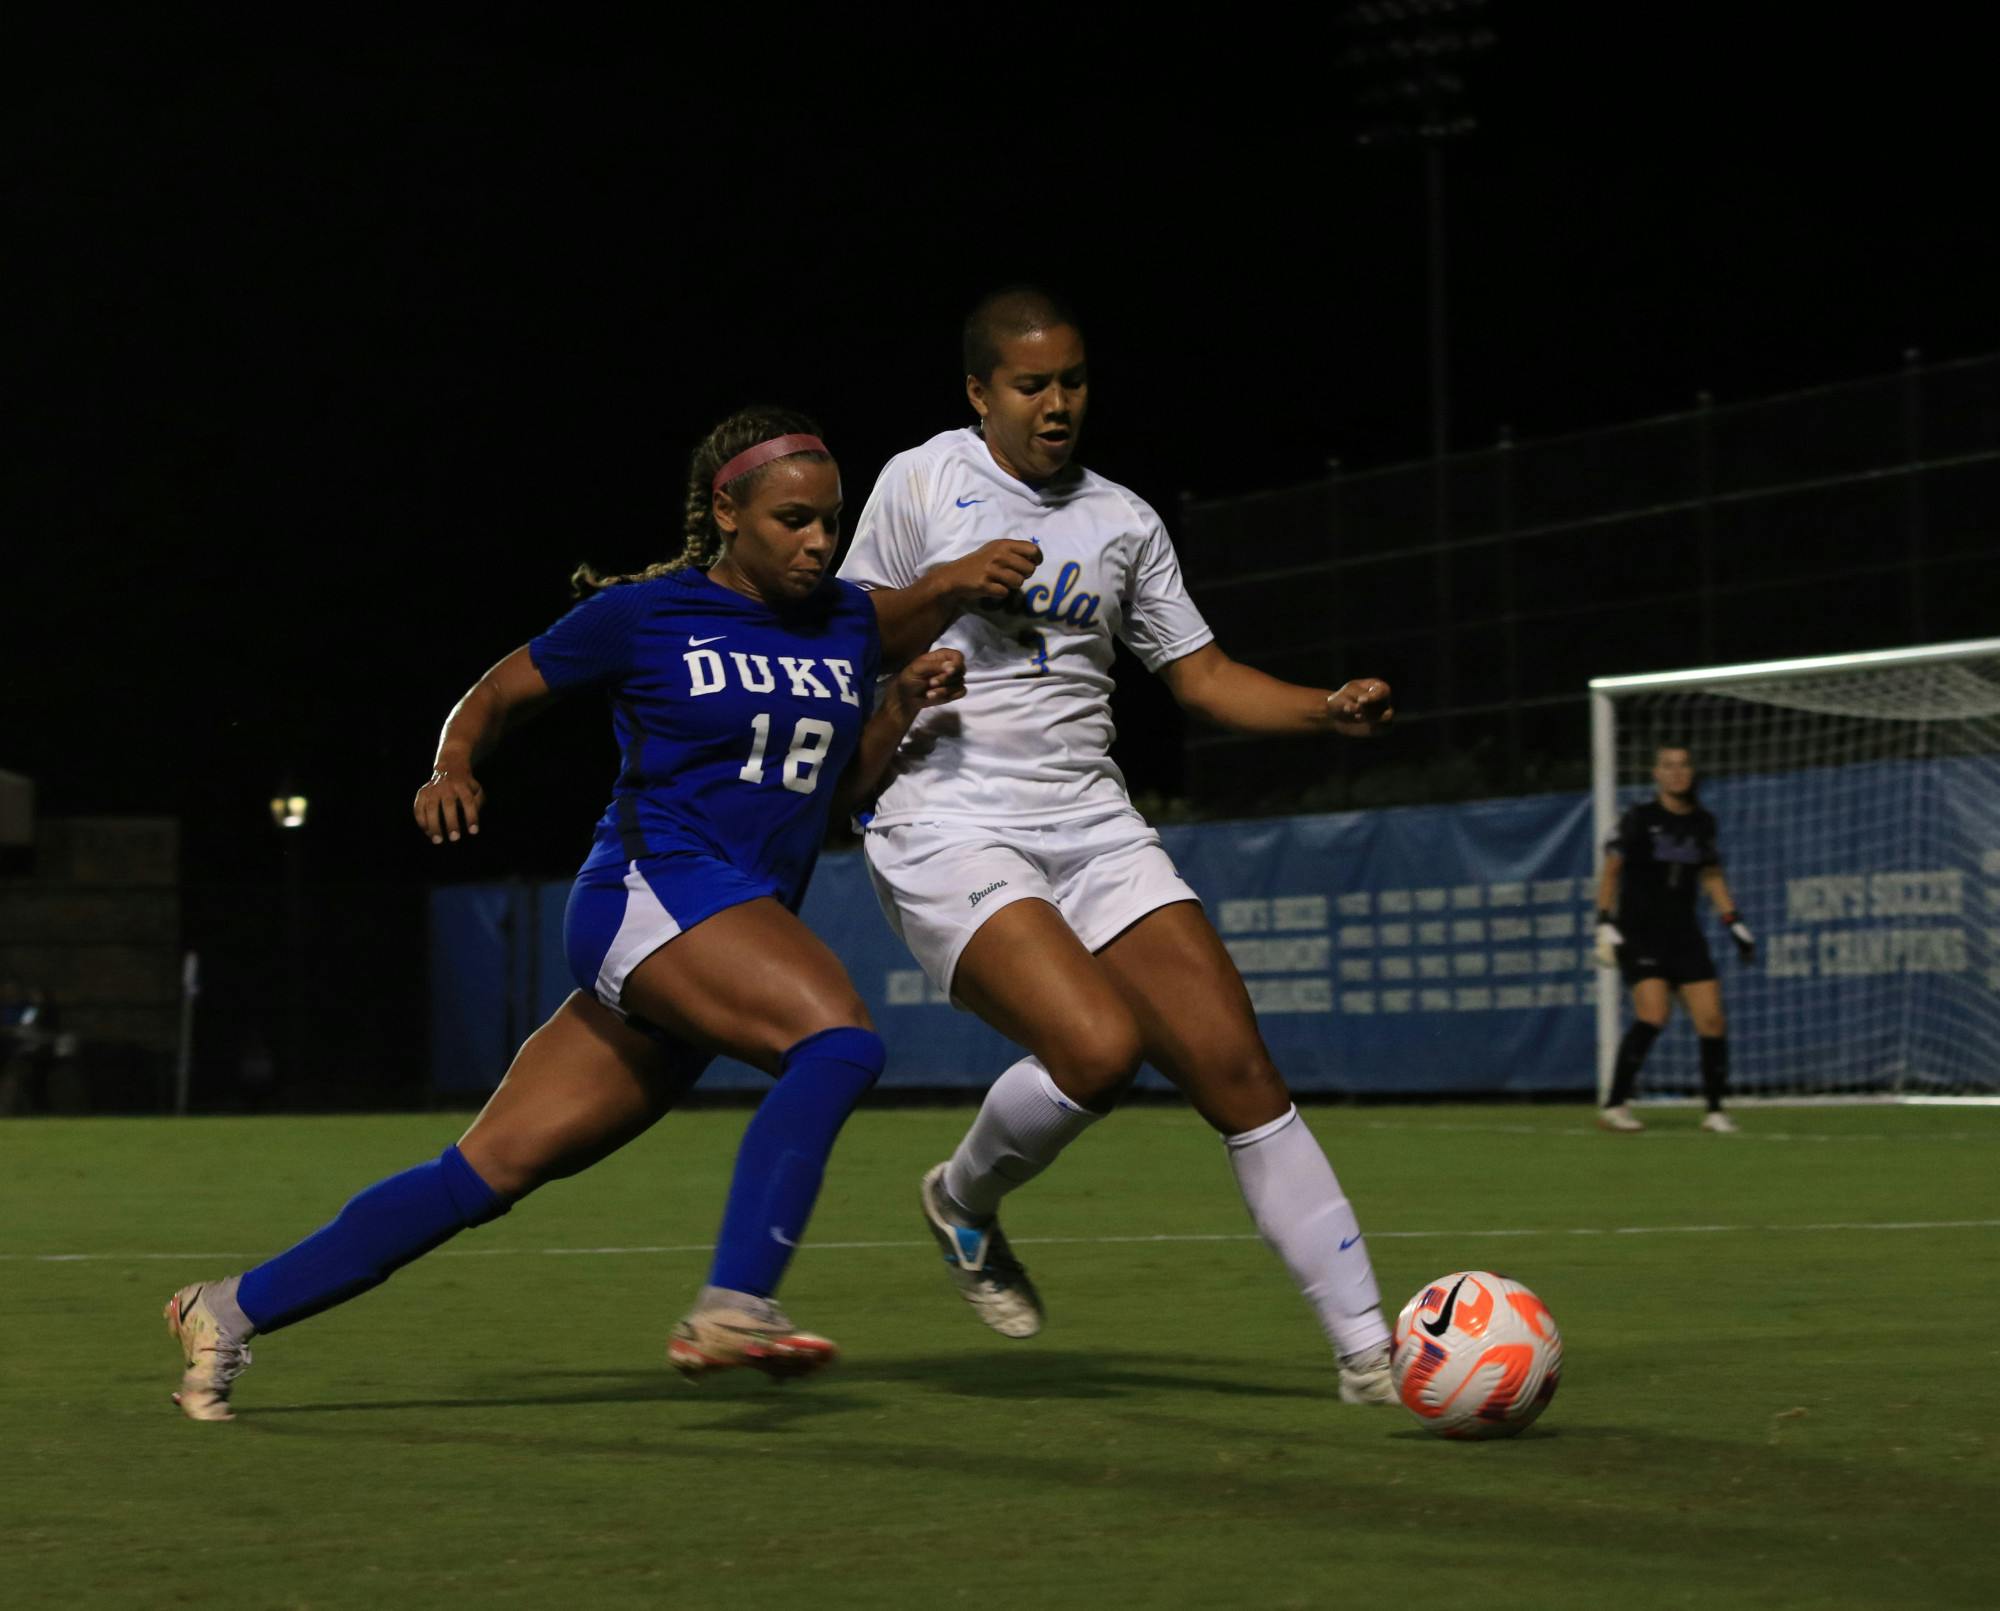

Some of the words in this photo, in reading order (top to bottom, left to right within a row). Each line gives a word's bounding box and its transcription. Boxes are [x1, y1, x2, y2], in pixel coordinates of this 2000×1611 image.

[682, 649, 860, 708] DUKE
[738, 713, 835, 794] 18
[968, 880, 1008, 908] Bruins
